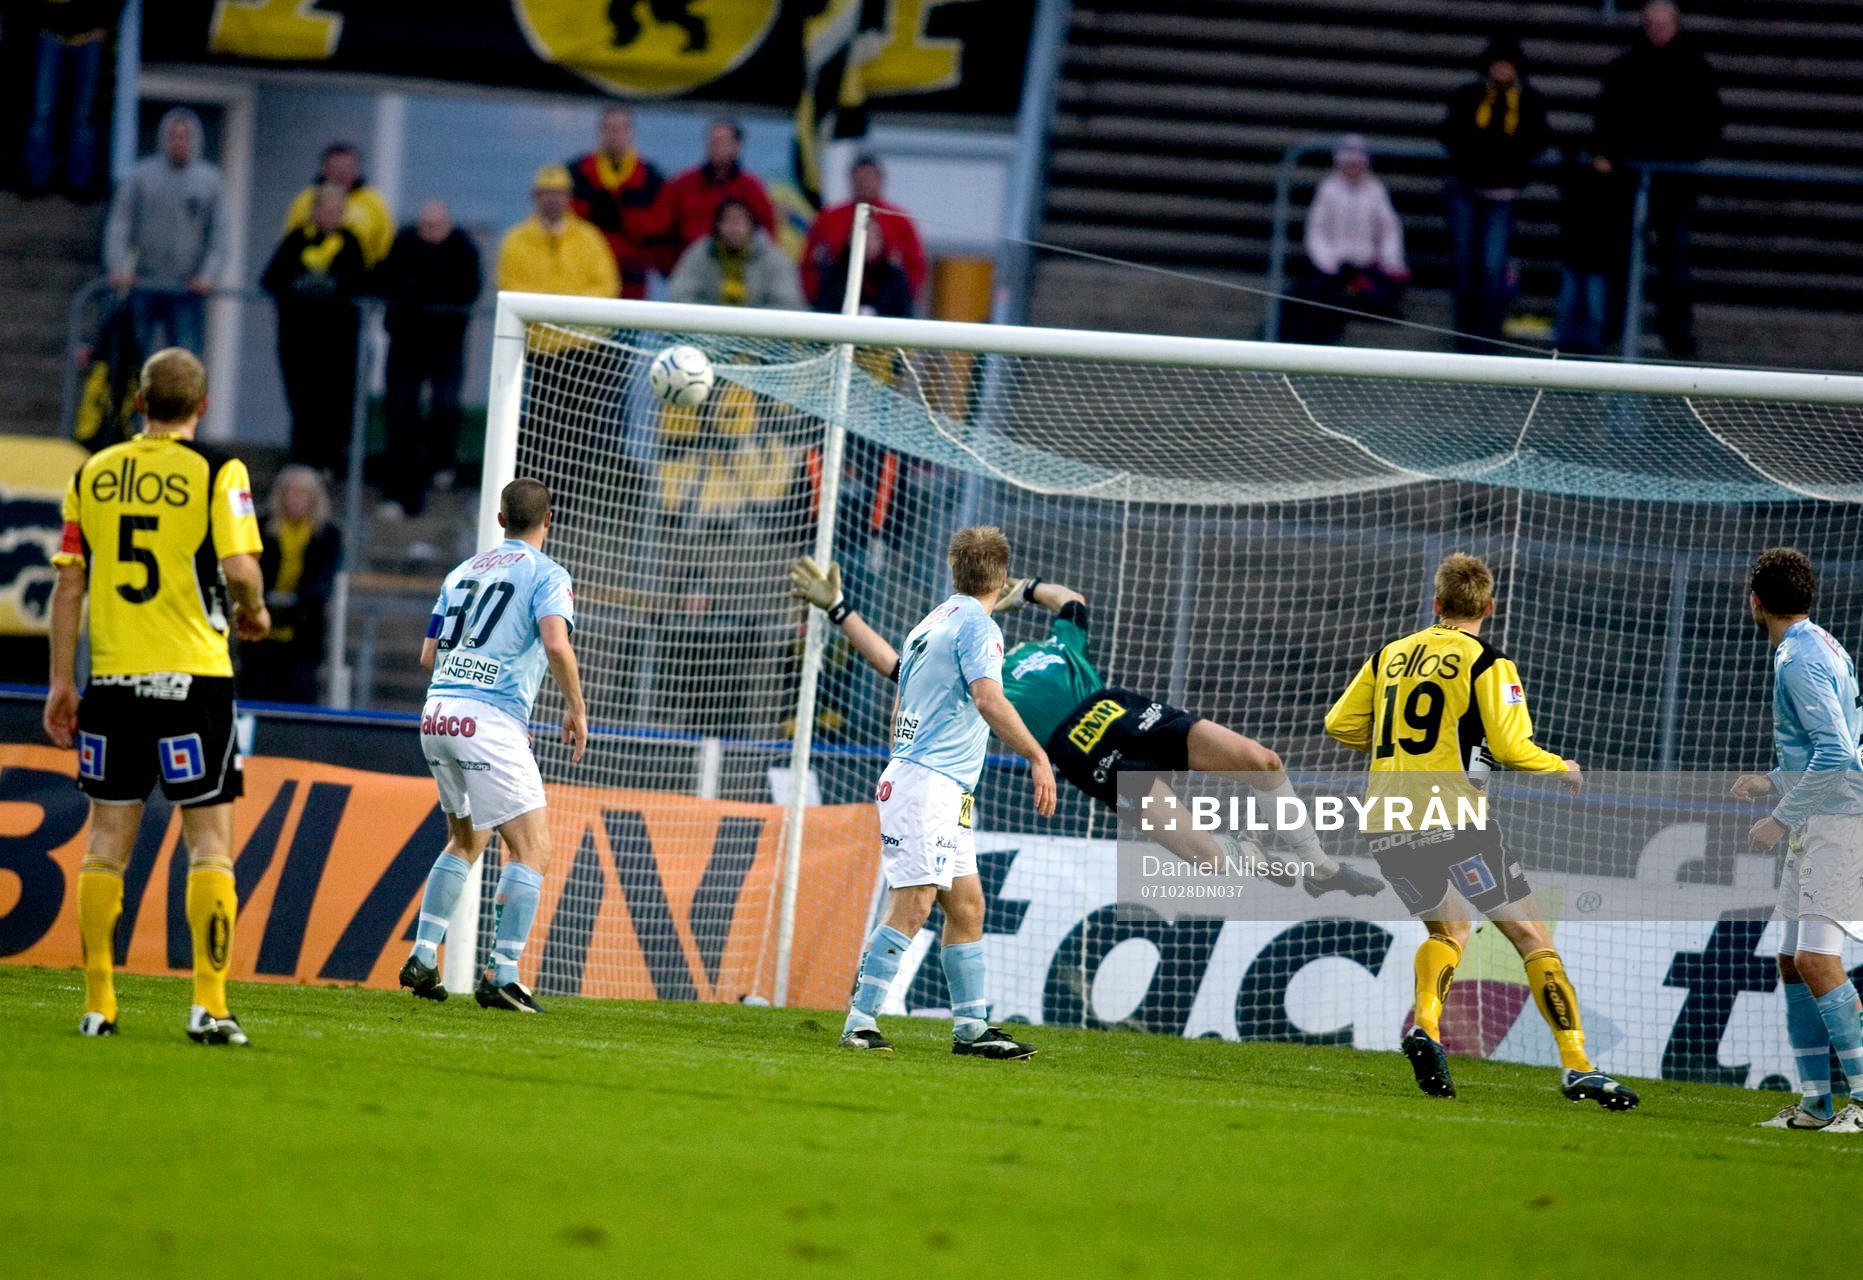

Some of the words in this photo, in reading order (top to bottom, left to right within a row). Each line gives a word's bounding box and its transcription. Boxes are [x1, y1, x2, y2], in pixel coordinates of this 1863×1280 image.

[92, 457, 189, 507] ellos
[115, 514, 160, 604] 5
[437, 579, 516, 650] 30
[1386, 644, 1460, 679] ellos
[421, 702, 477, 738] alaco
[1376, 681, 1445, 759] 19
